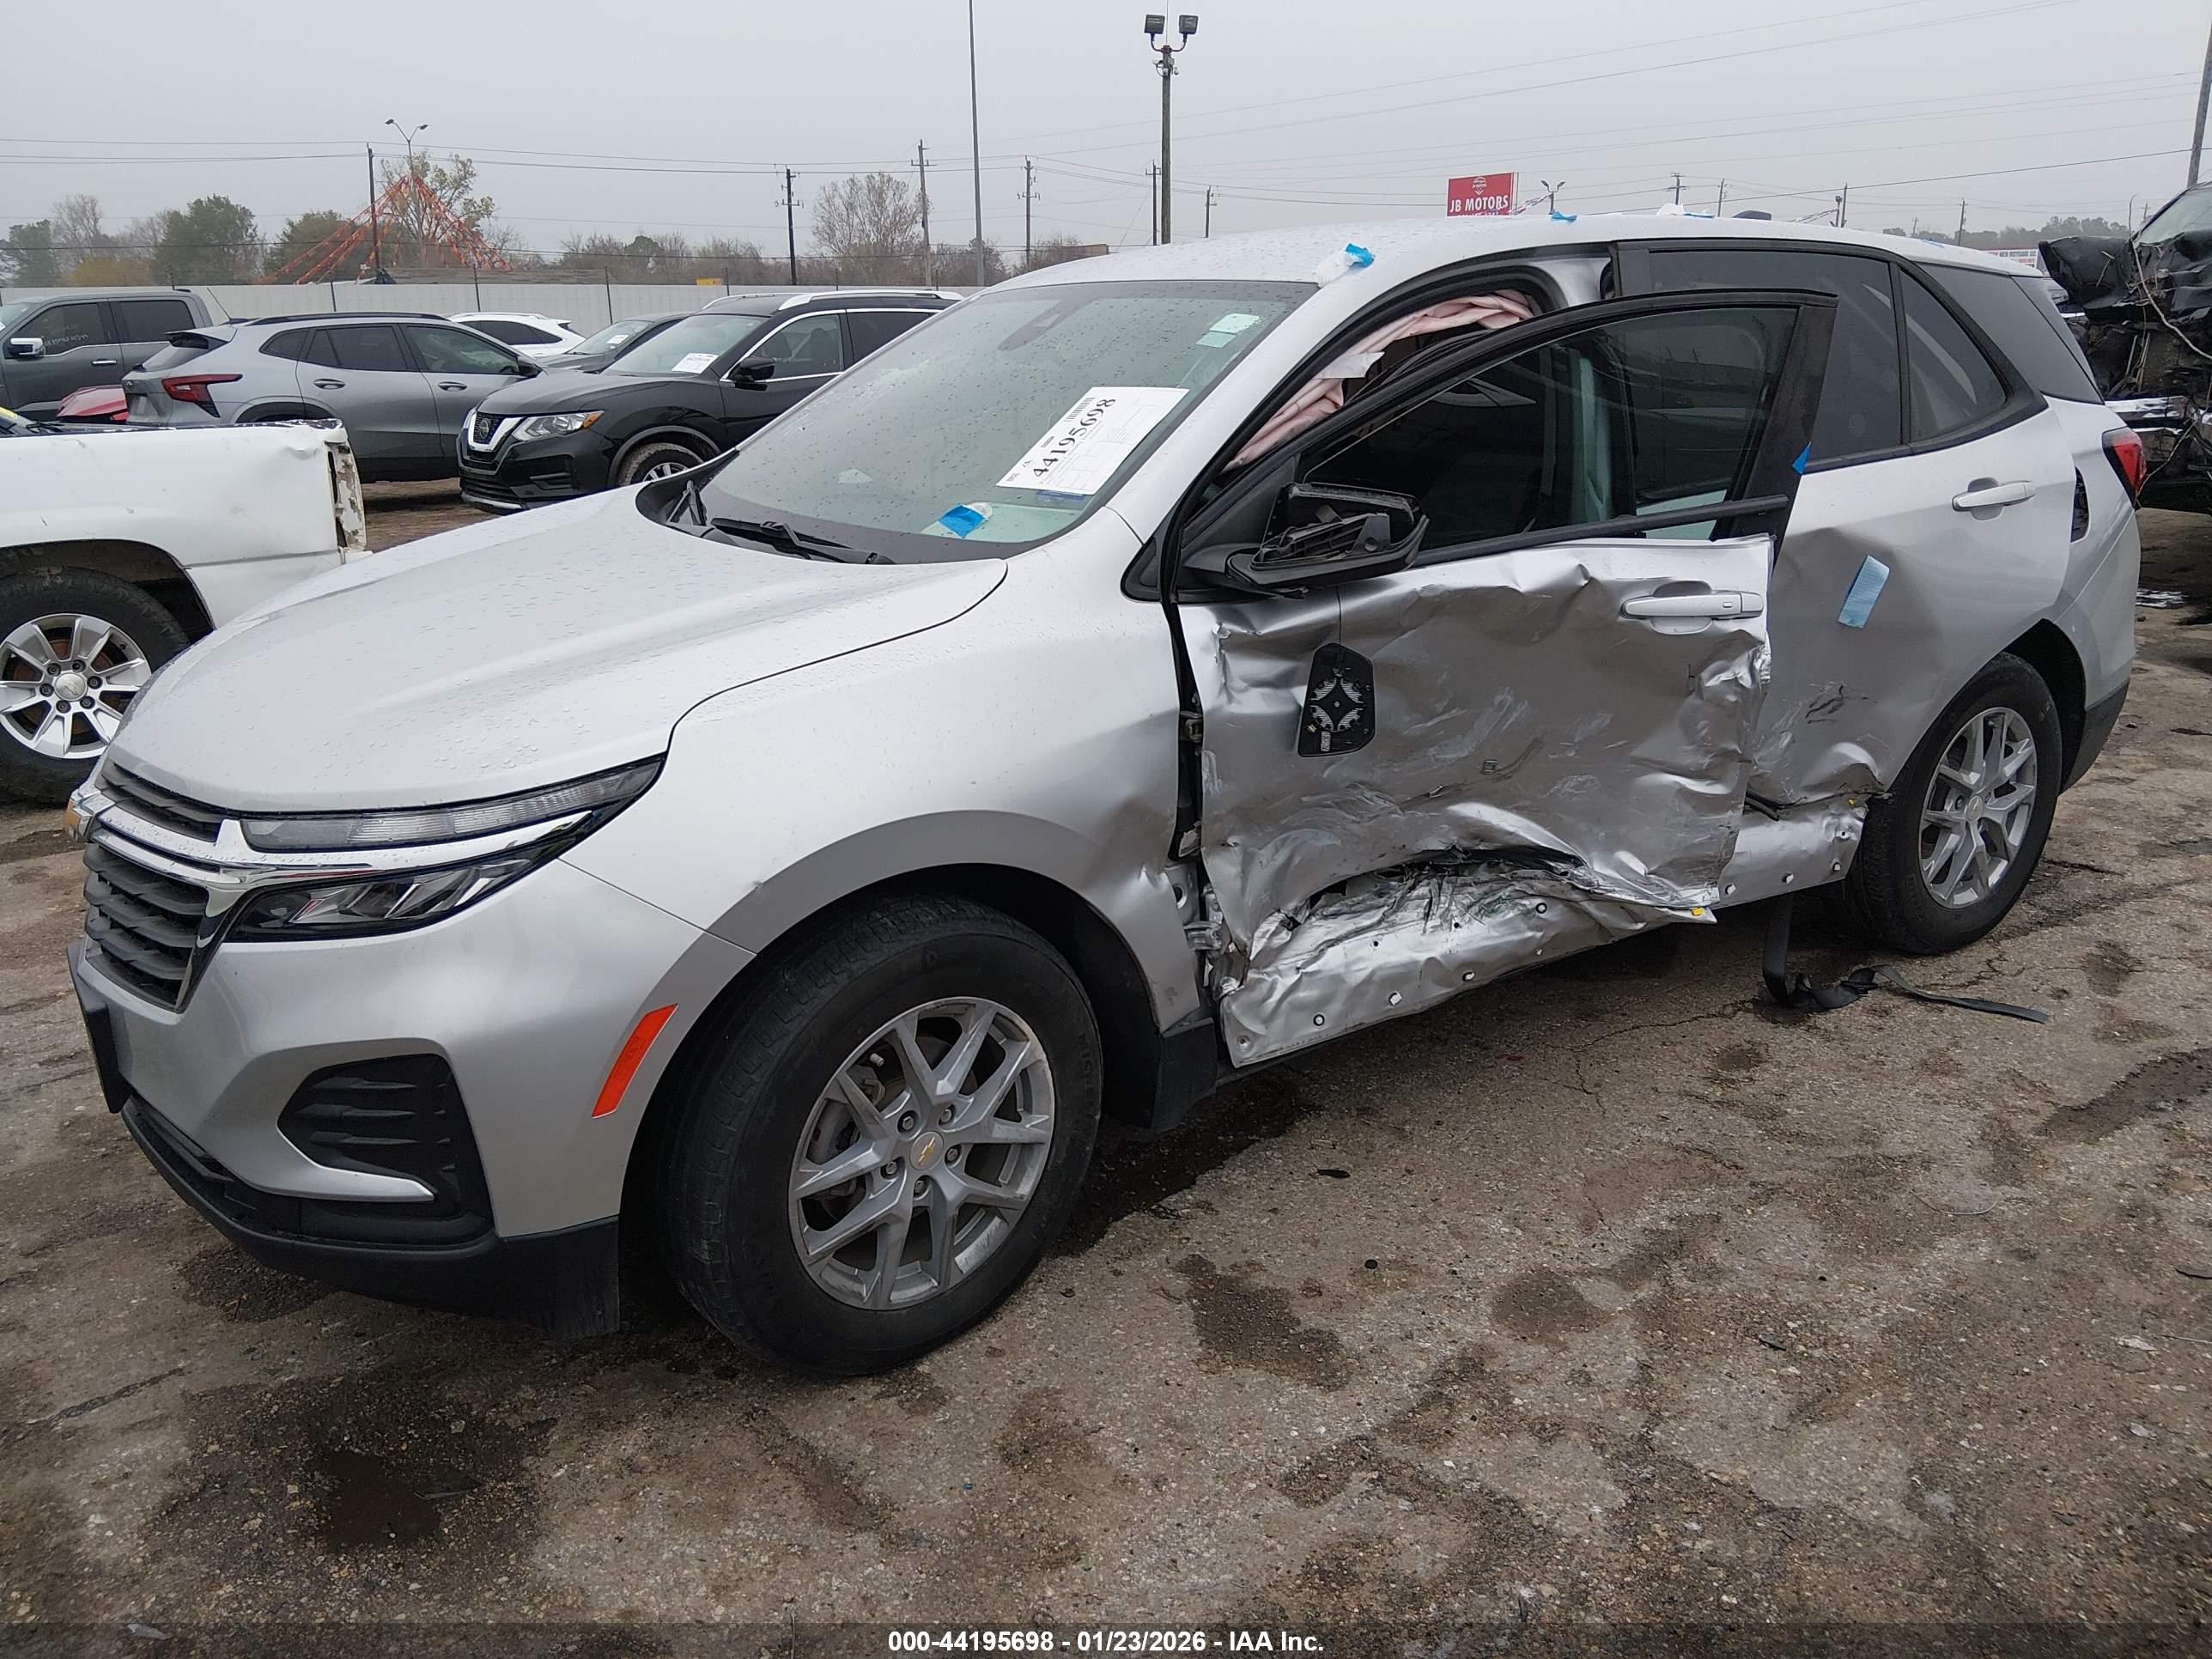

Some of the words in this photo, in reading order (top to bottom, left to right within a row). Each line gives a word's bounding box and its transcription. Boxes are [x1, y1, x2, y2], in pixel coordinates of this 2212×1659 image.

[1449, 199, 1462, 213] JB
[1465, 195, 1509, 211] MOTORS
[1033, 398, 1116, 477] 44195698
